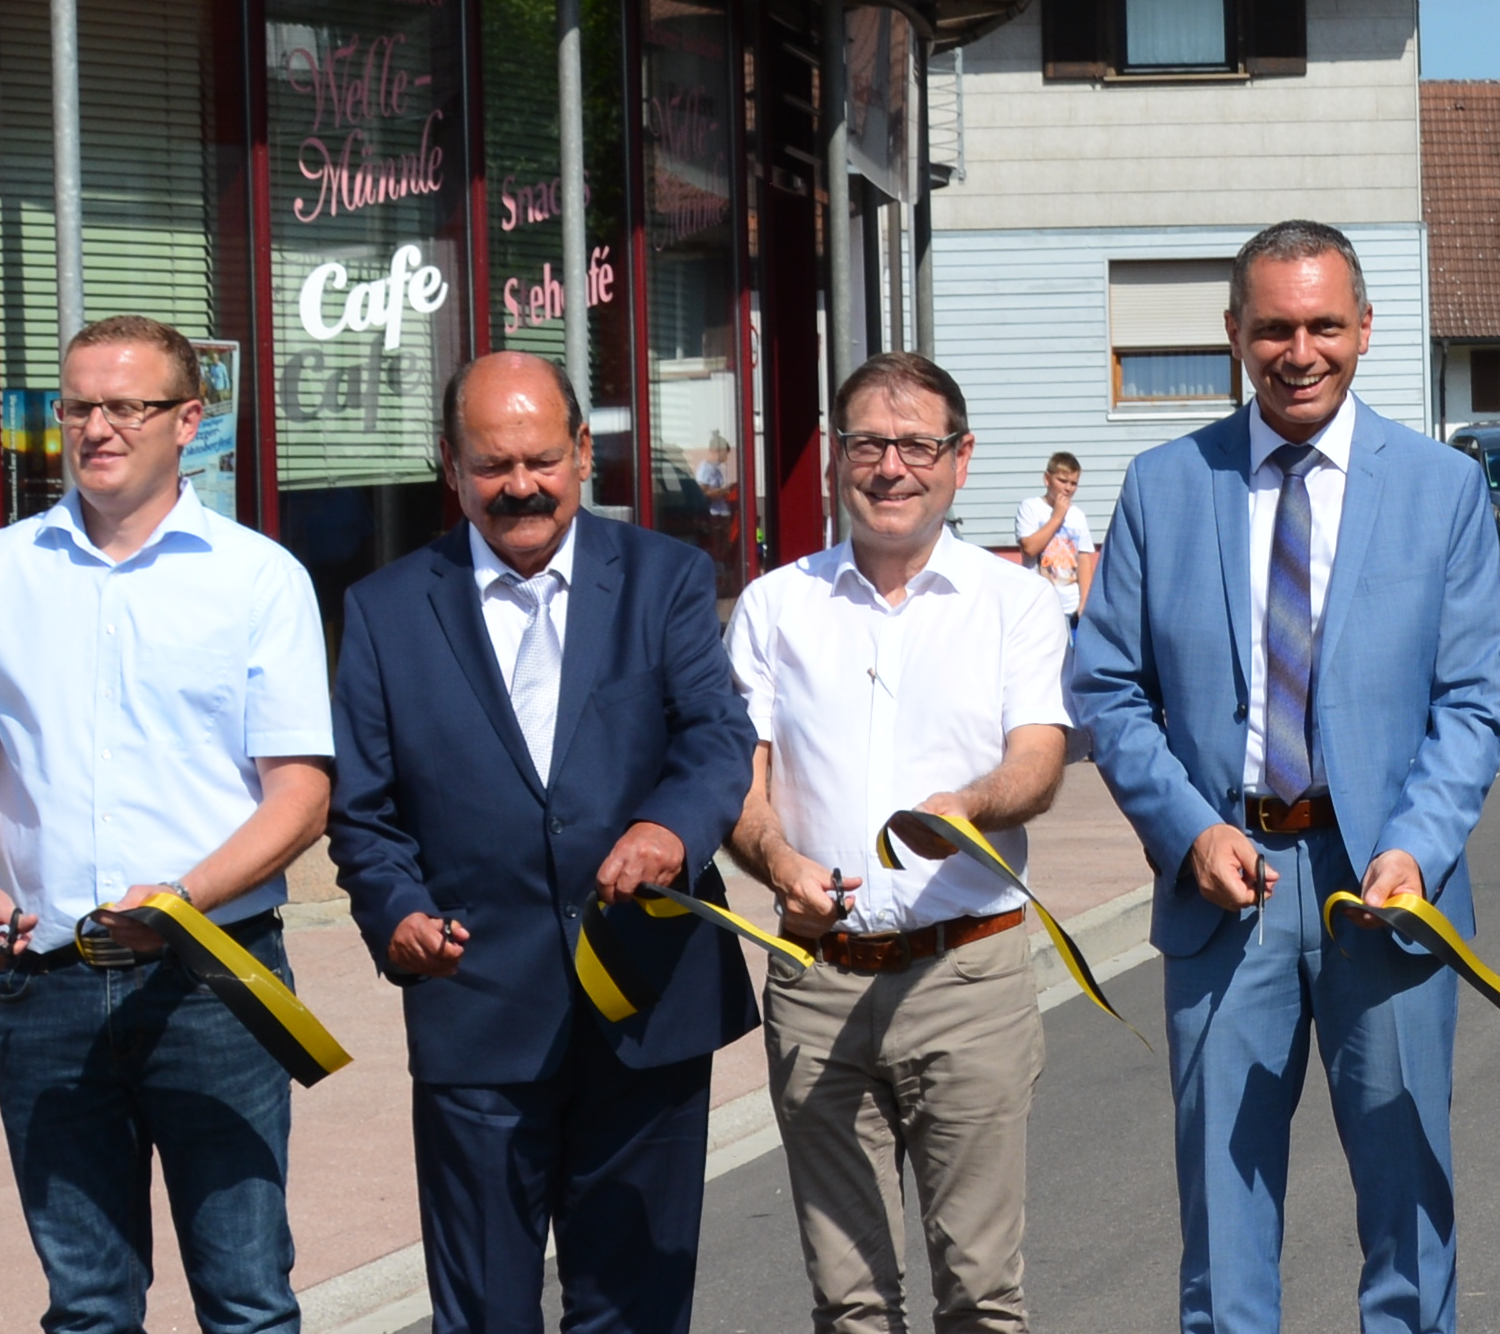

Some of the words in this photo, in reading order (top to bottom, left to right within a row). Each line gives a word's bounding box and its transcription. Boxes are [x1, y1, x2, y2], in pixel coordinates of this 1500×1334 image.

[288, 33, 432, 132] Welle-
[294, 109, 443, 223] Männle
[299, 244, 448, 351] Cafe
[504, 246, 614, 335] Stehfé
